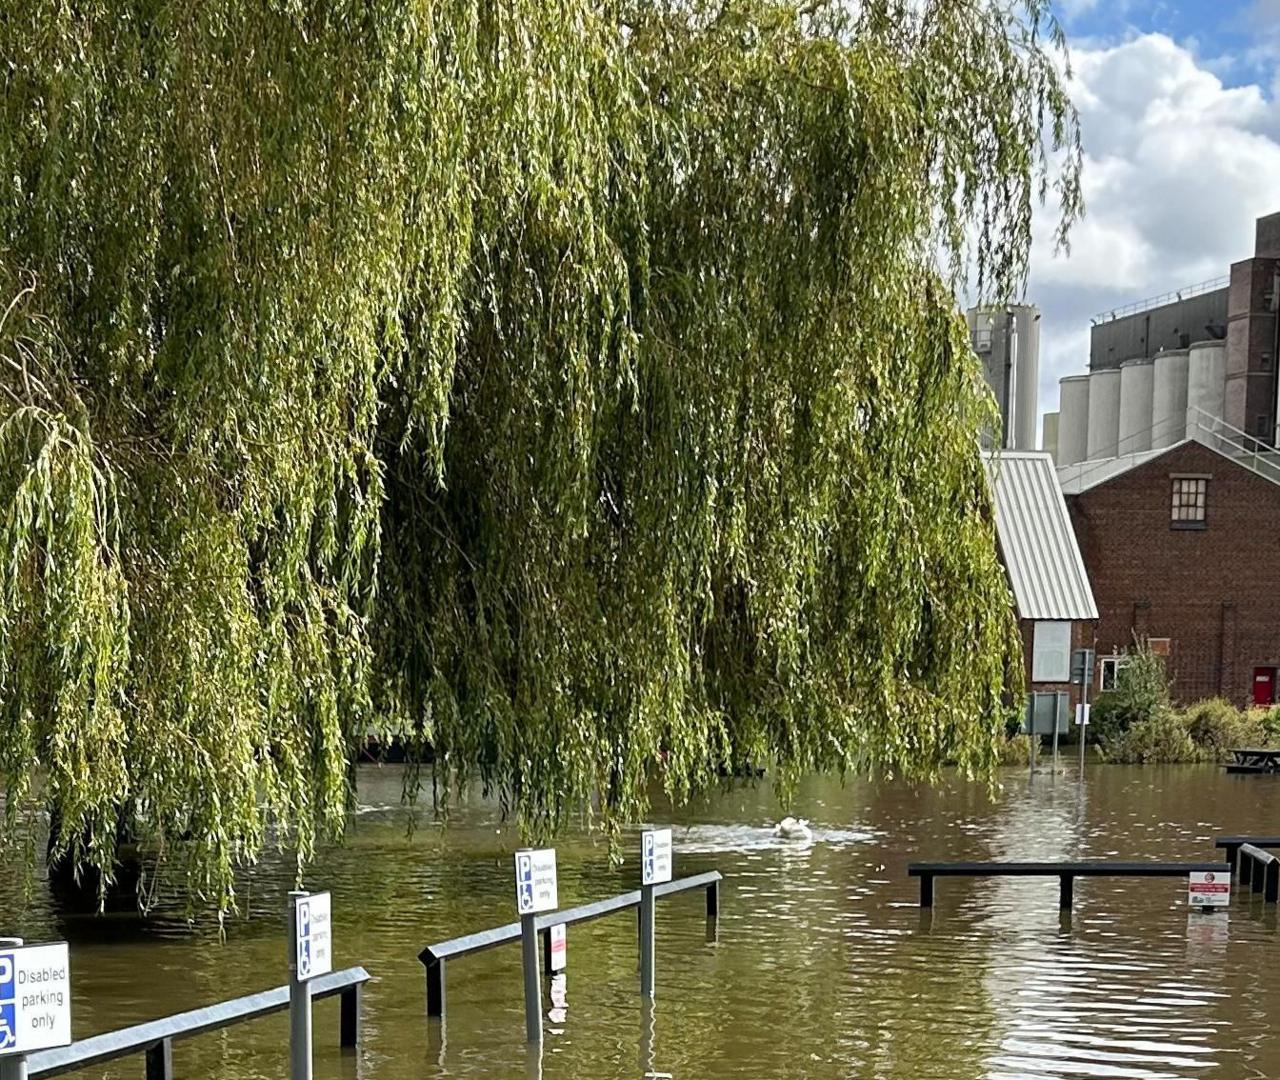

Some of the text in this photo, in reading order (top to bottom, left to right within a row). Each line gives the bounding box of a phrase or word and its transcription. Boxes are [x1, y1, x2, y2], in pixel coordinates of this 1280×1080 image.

[18, 967, 66, 985] Disabled
[22, 990, 64, 1011] parking
[31, 1013, 56, 1030] only
